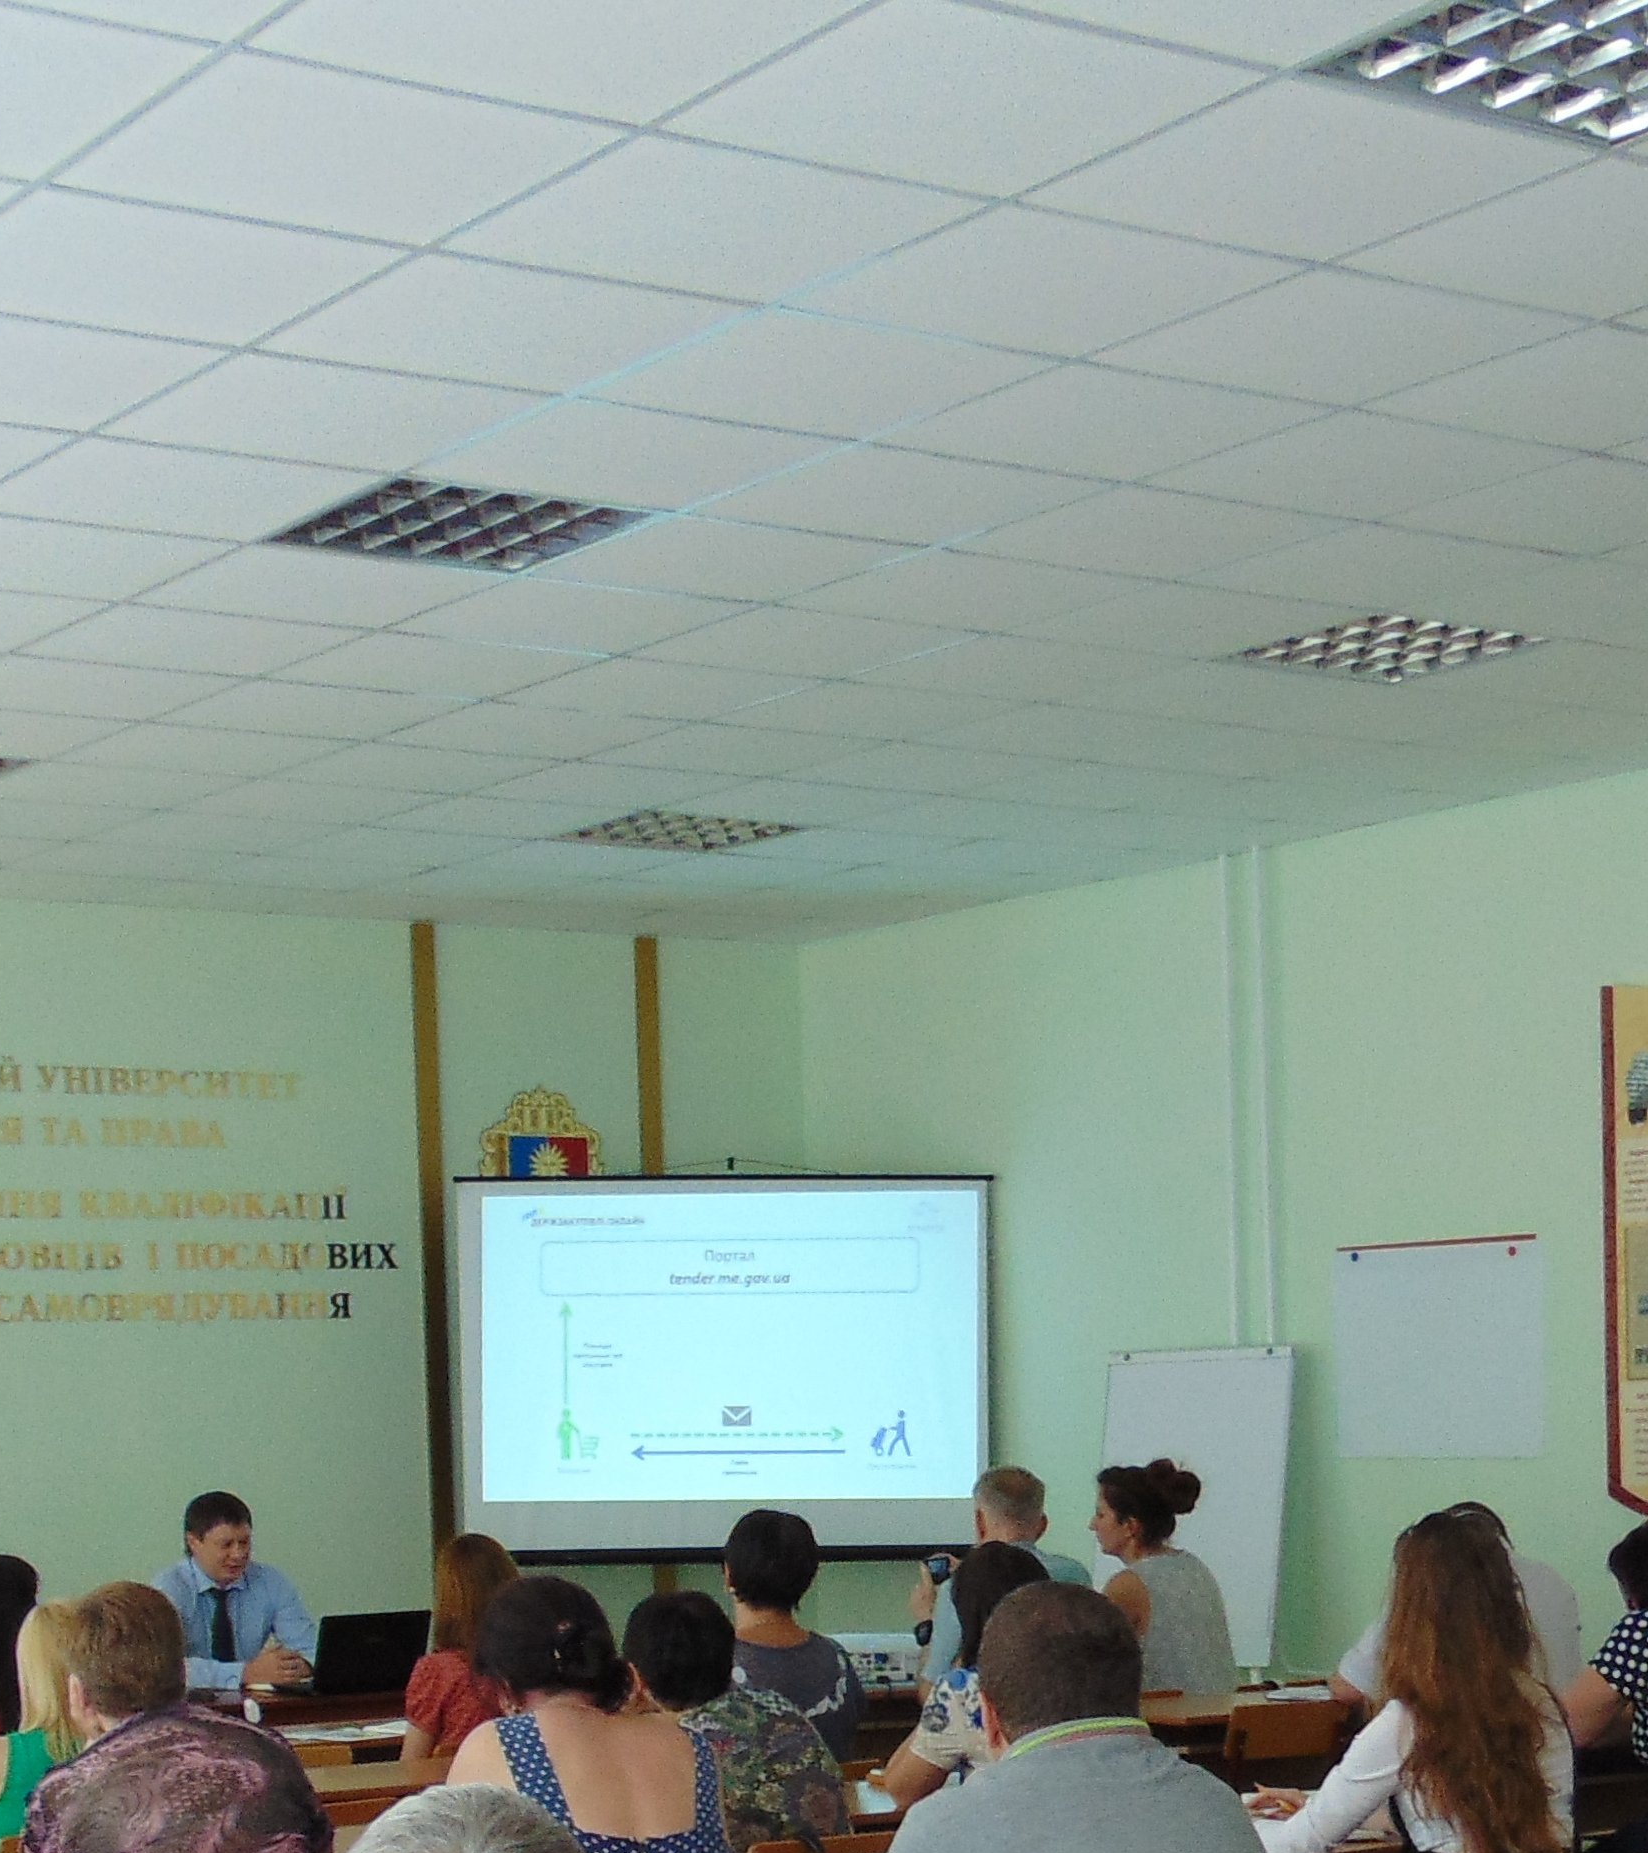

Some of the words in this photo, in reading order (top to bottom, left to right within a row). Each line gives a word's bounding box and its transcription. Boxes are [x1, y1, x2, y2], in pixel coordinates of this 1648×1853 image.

[37, 1064, 301, 1099] УНІВЕРСИТЕТ
[39, 1116, 88, 1146] ТА
[100, 1116, 227, 1149] ПРАВА
[175, 1242, 399, 1273] ПОСАДОВИХ
[703, 1249, 755, 1263] Портал
[668, 1271, 791, 1288] tender.me.gov.ua
